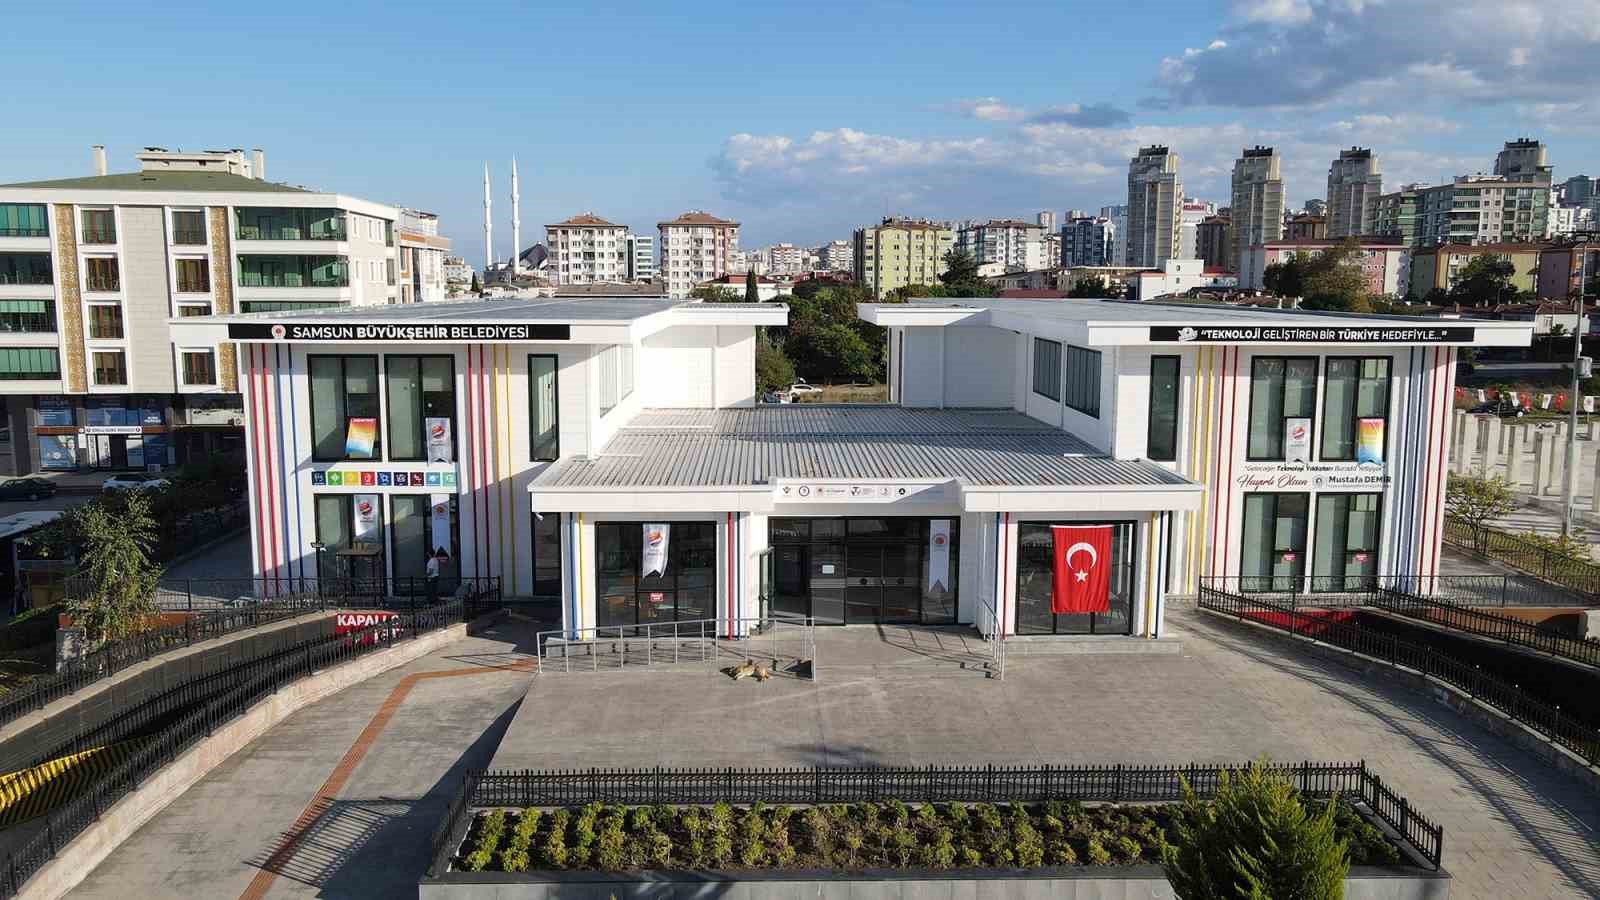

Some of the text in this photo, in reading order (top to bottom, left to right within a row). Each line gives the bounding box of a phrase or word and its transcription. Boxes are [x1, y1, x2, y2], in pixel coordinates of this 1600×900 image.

[293, 324, 529, 341] SAMSUN BÜYÜKŞEHİR BELEDİYESİ
[1262, 328, 1319, 341] GELİŞTİREN
[1319, 329, 1336, 340] BİR
[1338, 328, 1380, 340] TÜRKİYE
[1329, 475, 1392, 483] Mustafa DEMİR
